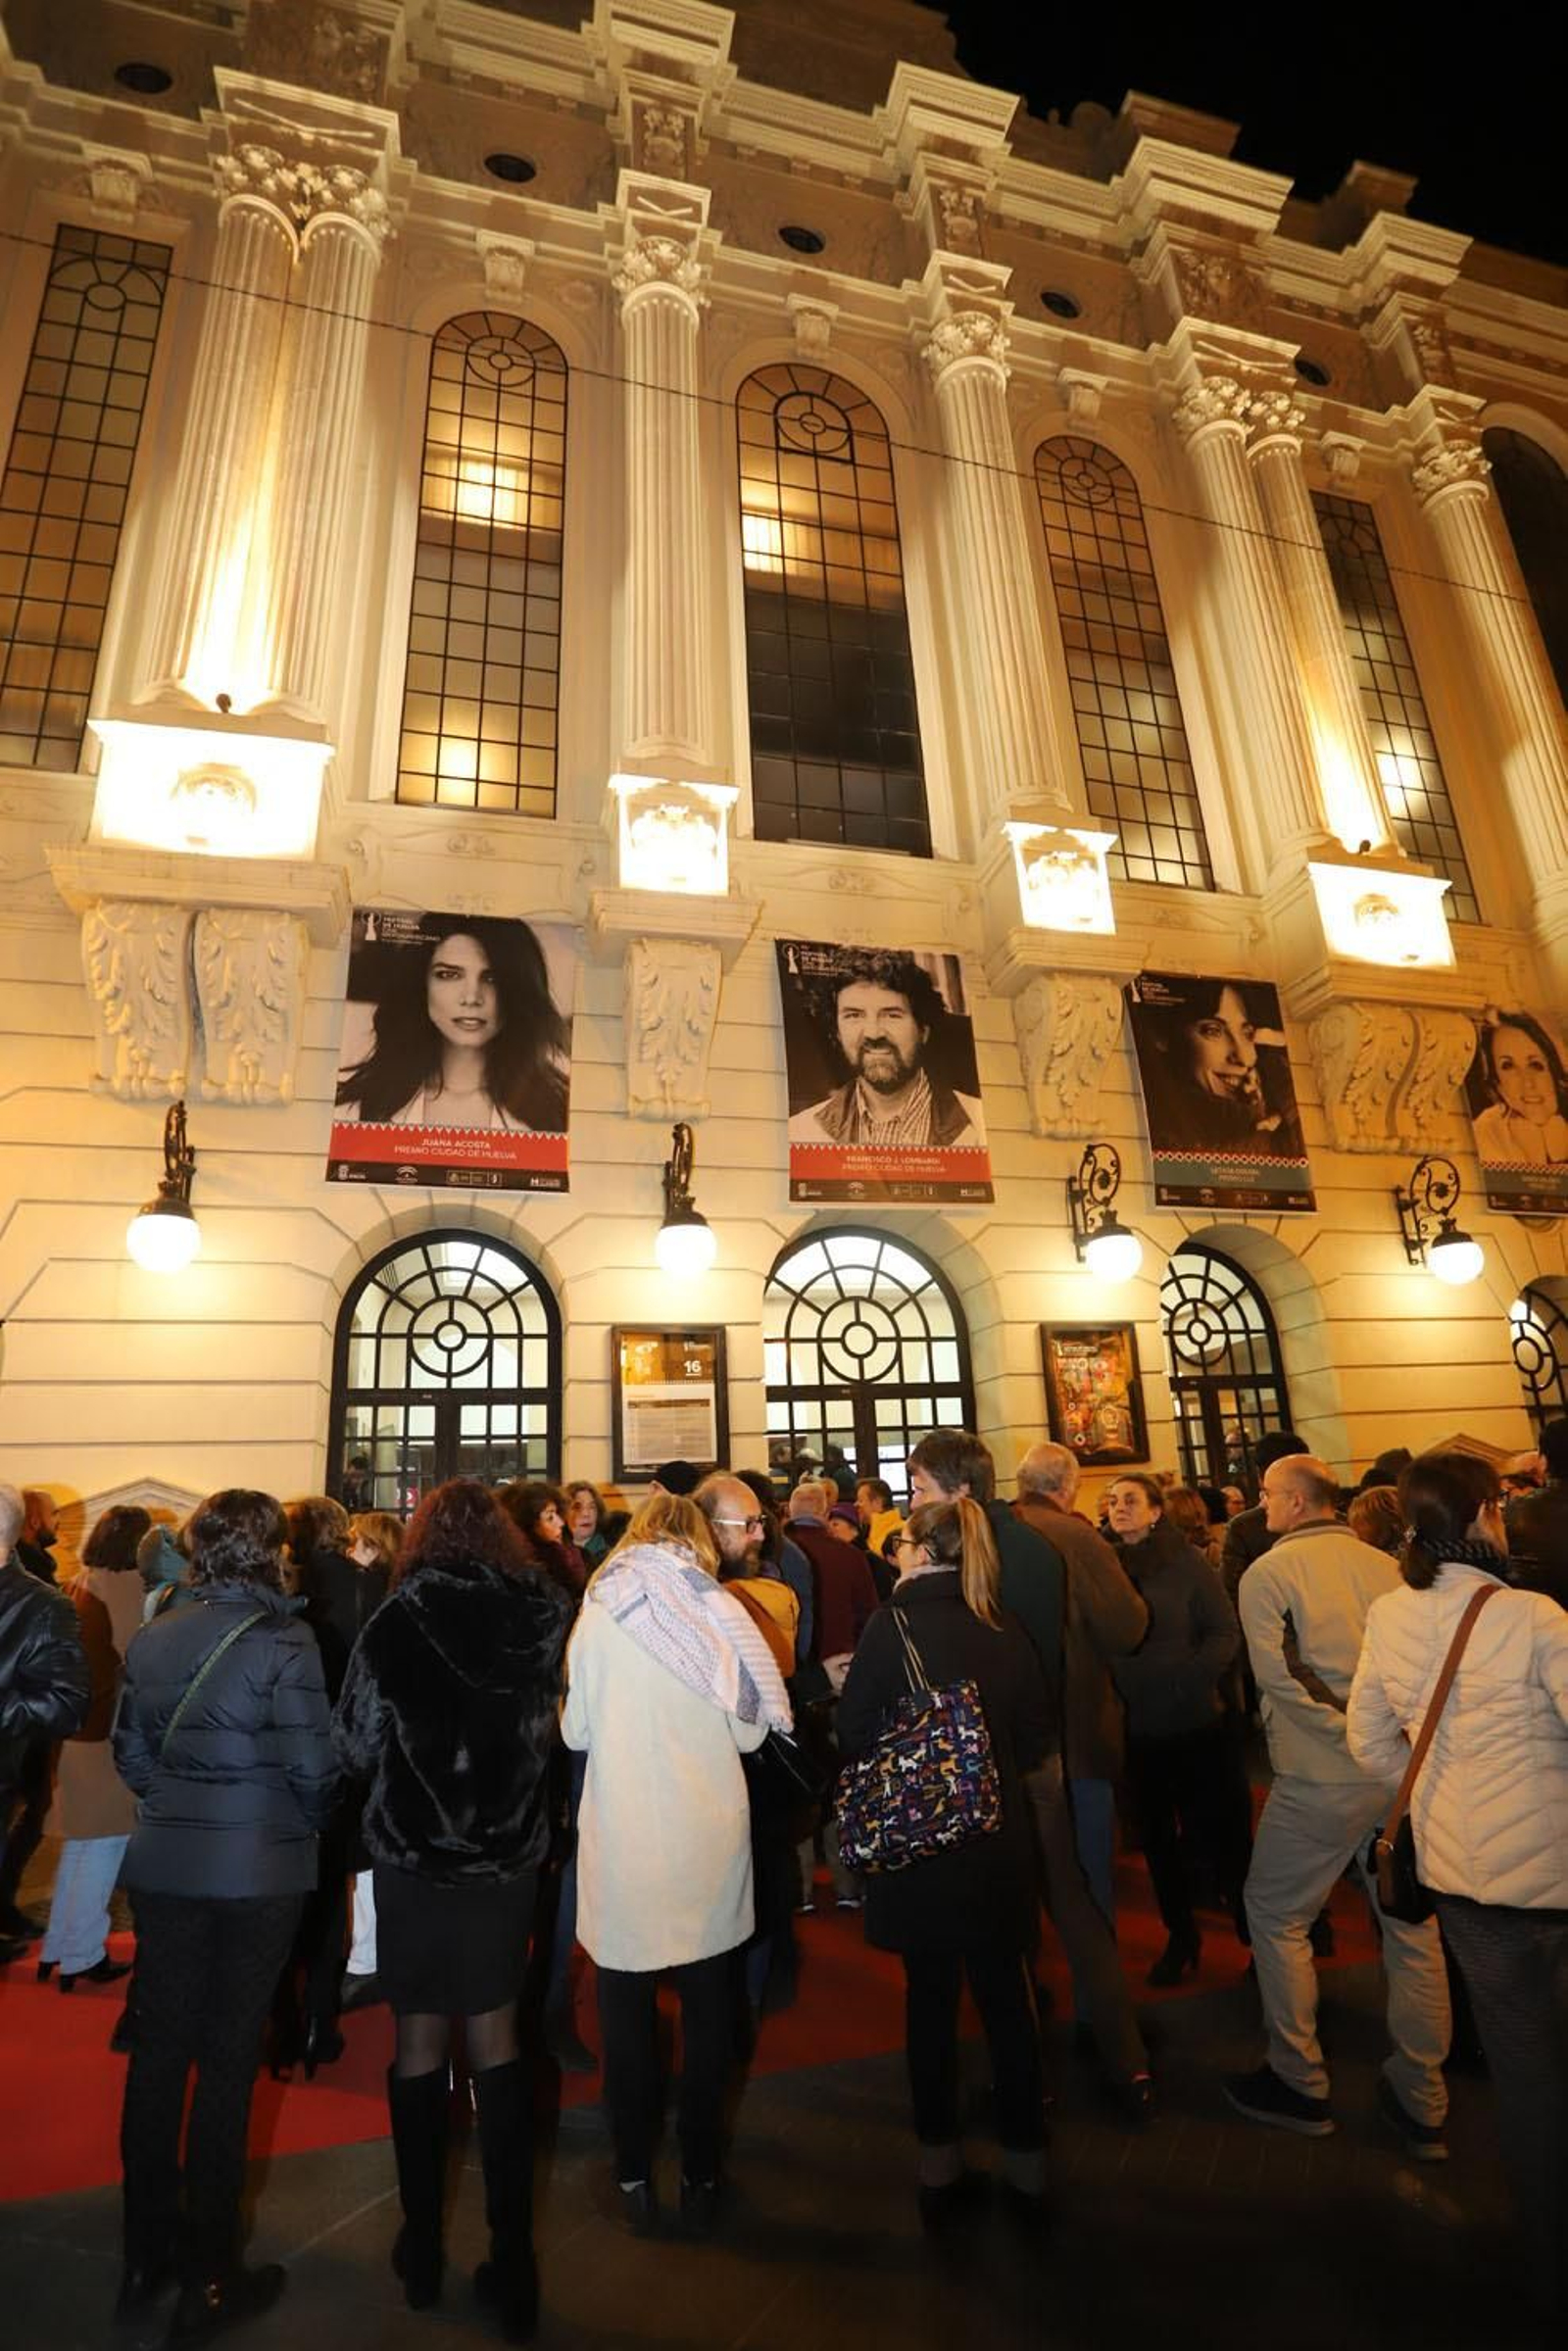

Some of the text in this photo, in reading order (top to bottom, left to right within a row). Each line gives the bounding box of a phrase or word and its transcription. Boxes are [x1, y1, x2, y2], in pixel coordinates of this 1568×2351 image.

[422, 1138, 491, 1150] JUANA ACOSTA
[394, 1145, 429, 1155] PREMIO
[431, 1148, 466, 1157] CIUDAD
[467, 1149, 479, 1157] DE
[684, 1360, 702, 1373] 16
